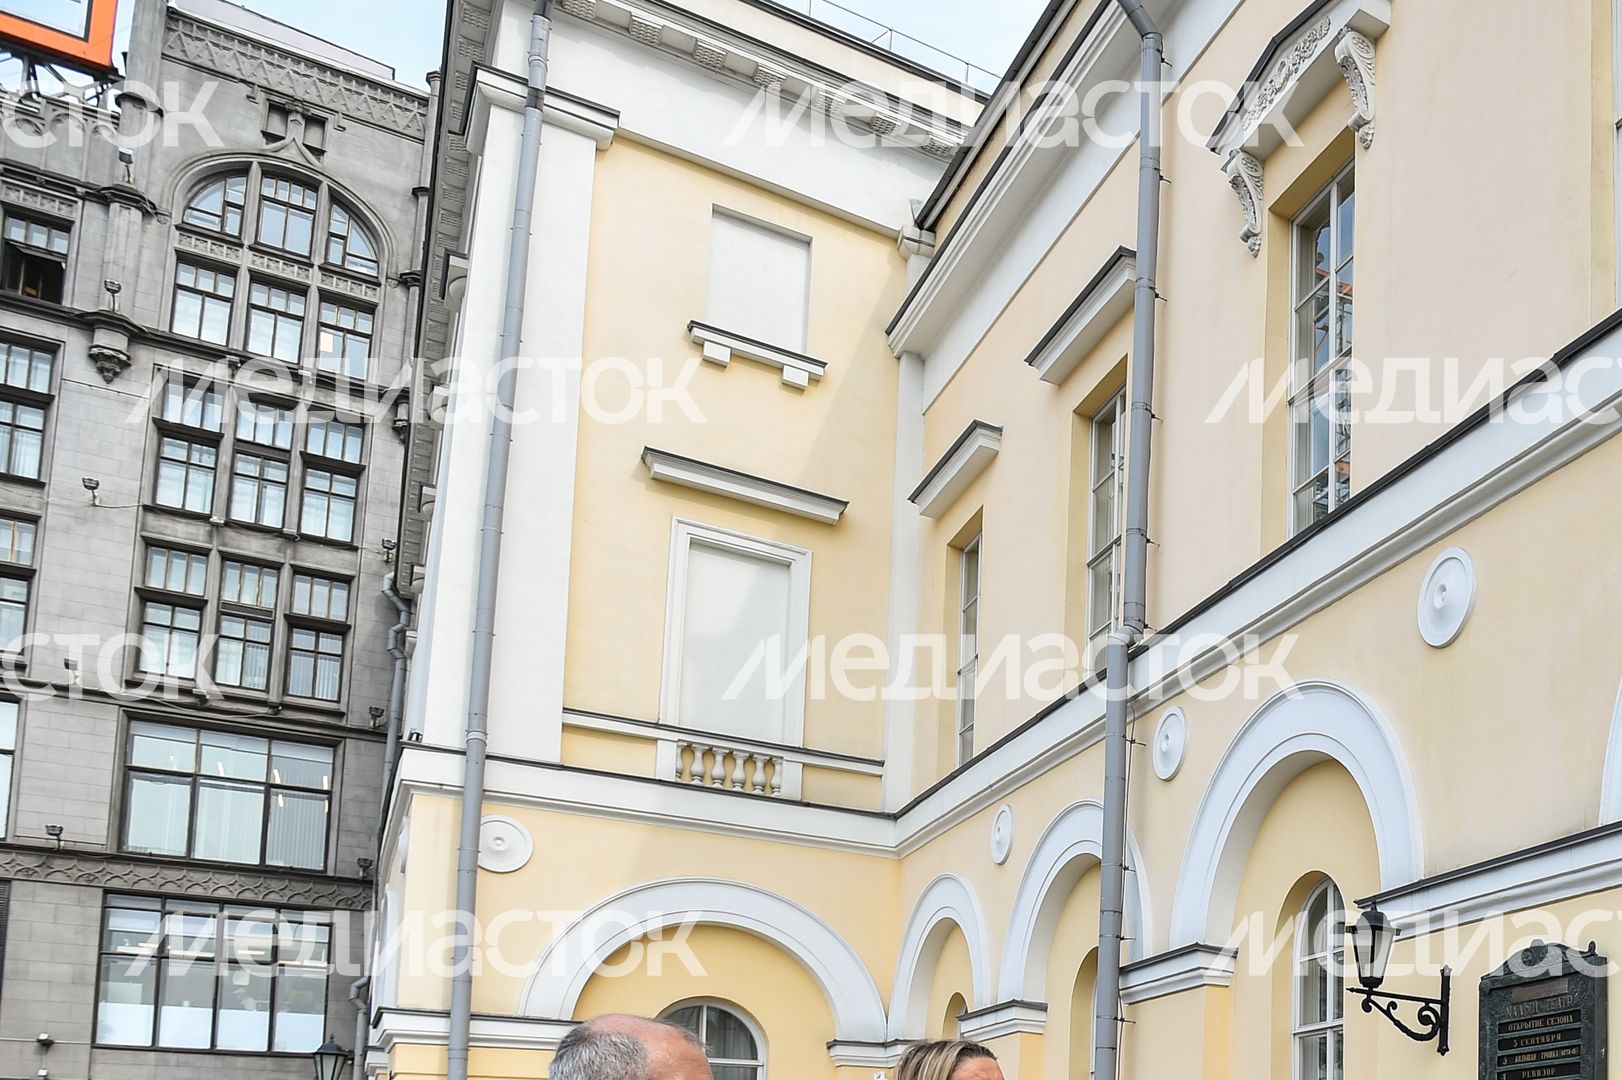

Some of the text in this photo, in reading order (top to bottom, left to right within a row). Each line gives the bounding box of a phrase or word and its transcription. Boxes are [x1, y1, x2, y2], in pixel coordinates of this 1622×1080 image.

[1508, 1014, 1573, 1031] ОТКРЫТИЕ СЕЗОНА
[1520, 1033, 1561, 1046] СЕНТЯБРЯ
[1522, 1067, 1556, 1078] РЕВИЗОР
